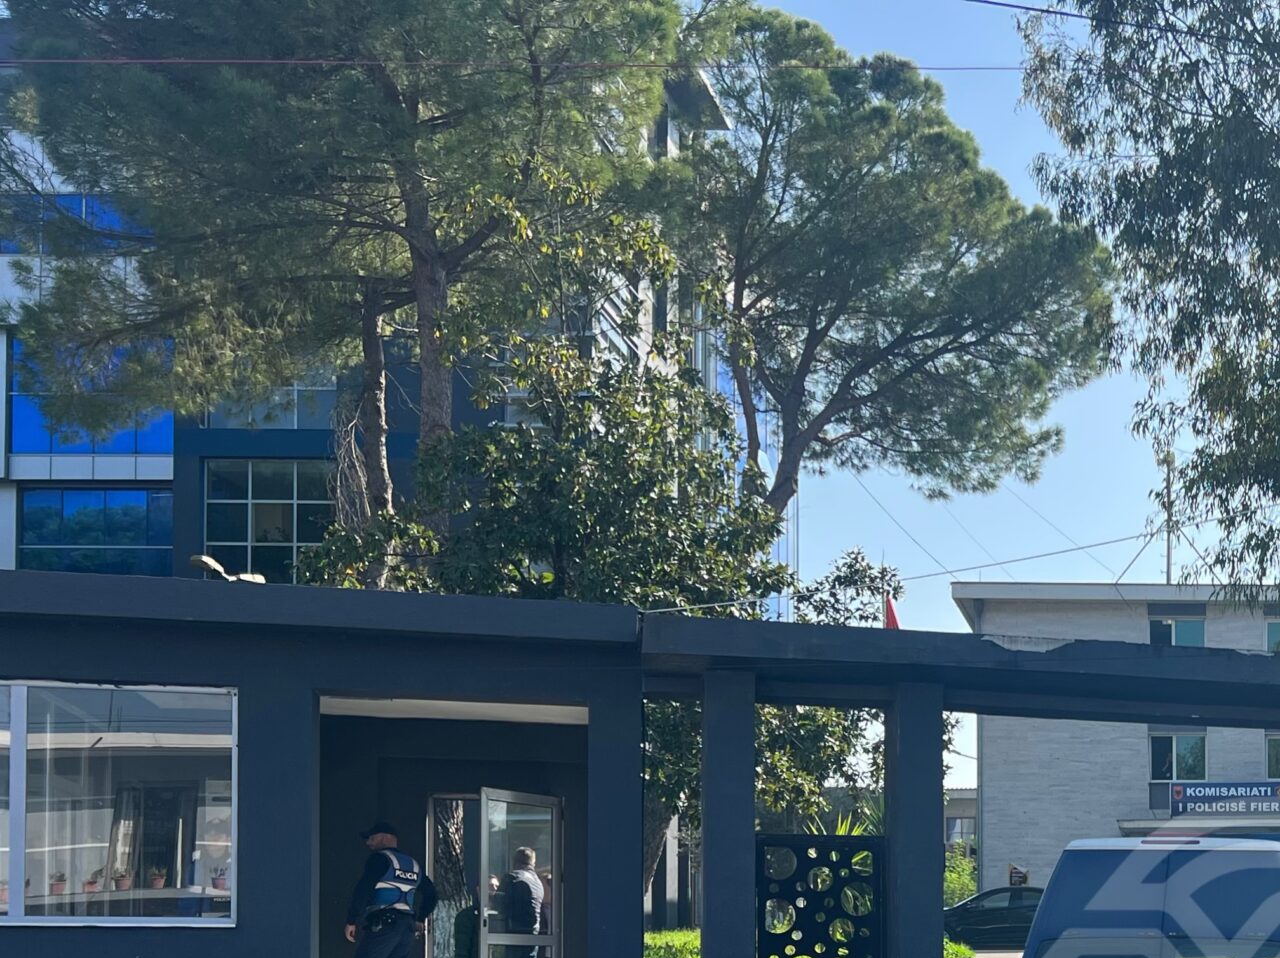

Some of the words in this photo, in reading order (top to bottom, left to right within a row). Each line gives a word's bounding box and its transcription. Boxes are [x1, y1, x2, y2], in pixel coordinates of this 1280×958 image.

[1186, 787, 1271, 797] KOMISARIATI
[1178, 802, 1183, 812] I
[1186, 800, 1246, 812] POLICISË
[1250, 802, 1280, 812] FIER
